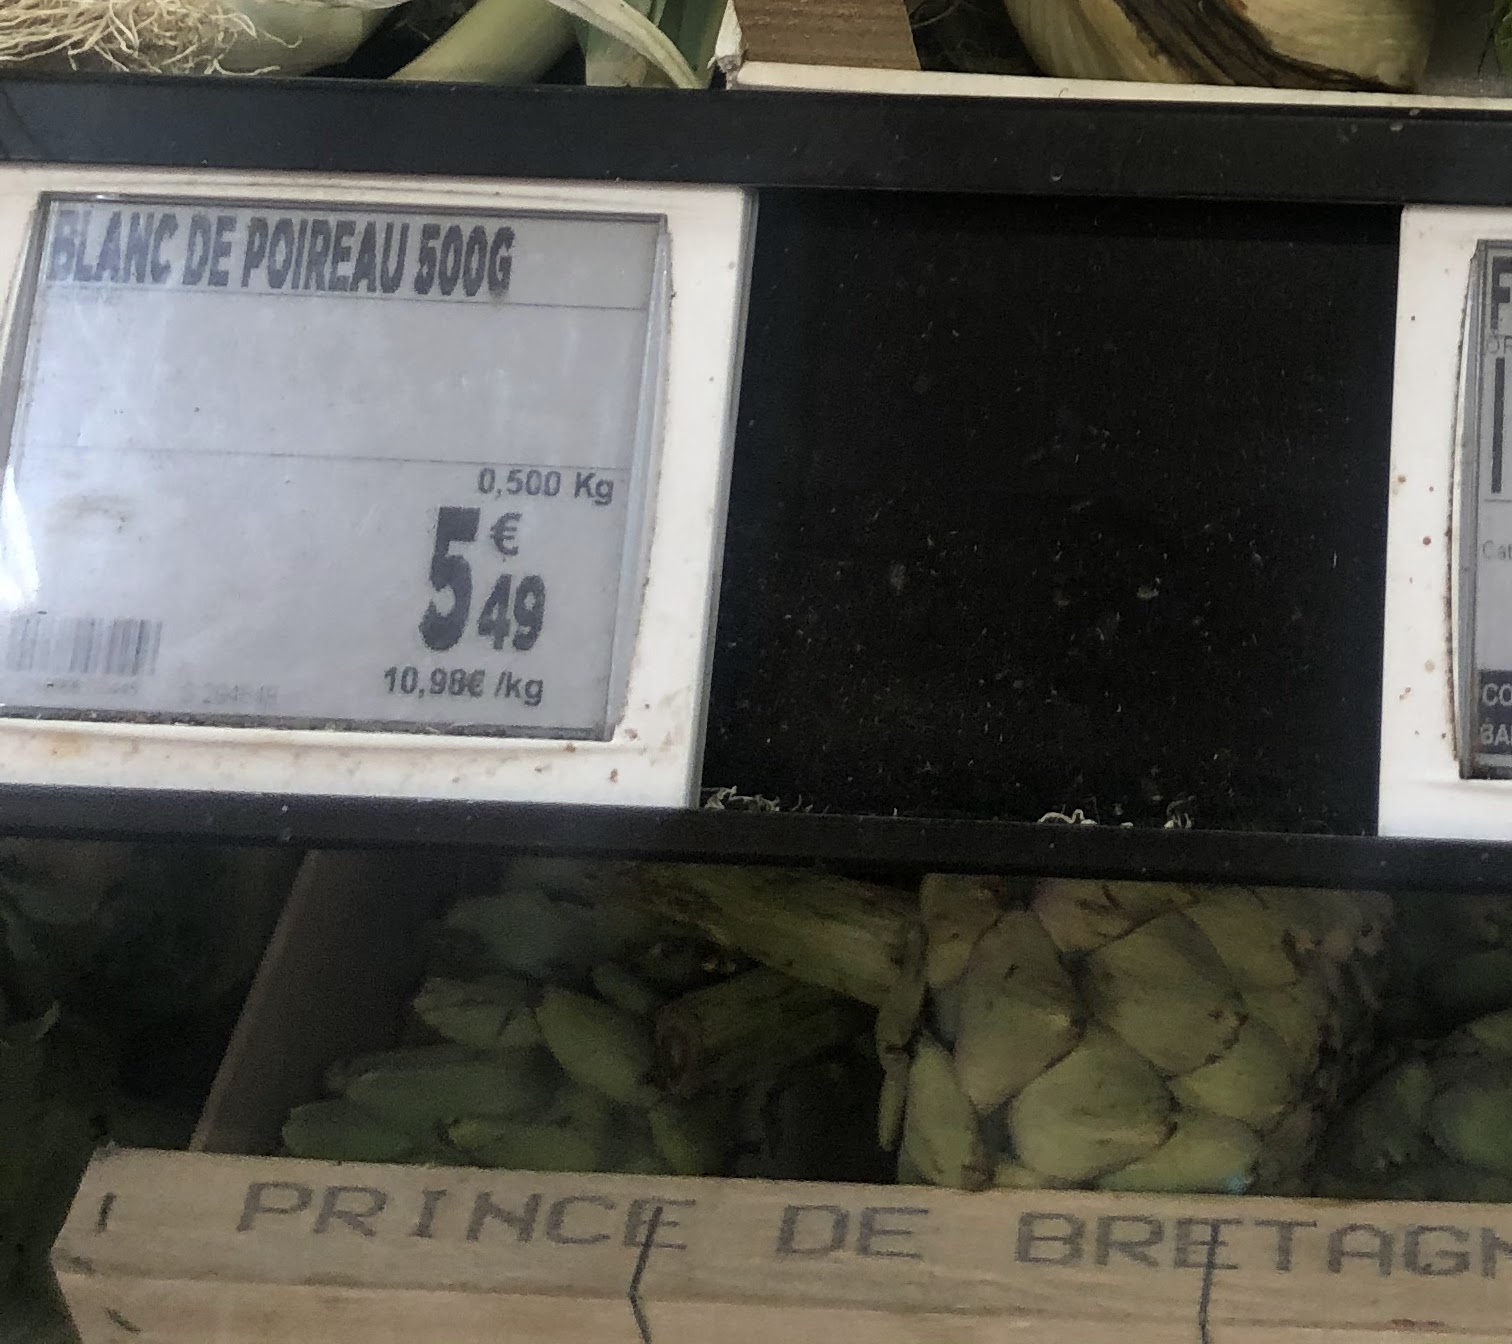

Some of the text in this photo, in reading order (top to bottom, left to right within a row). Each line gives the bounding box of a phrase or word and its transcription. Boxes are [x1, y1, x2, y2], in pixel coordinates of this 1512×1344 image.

[48, 210, 516, 297] BLANC DE POIREAU 500G
[477, 467, 615, 506] 0,500 Kg
[417, 506, 546, 652] 5 € 49
[384, 665, 544, 707] 10,98€ /kg
[235, 1180, 698, 1252] PRINCE
[776, 1202, 931, 1261] DE
